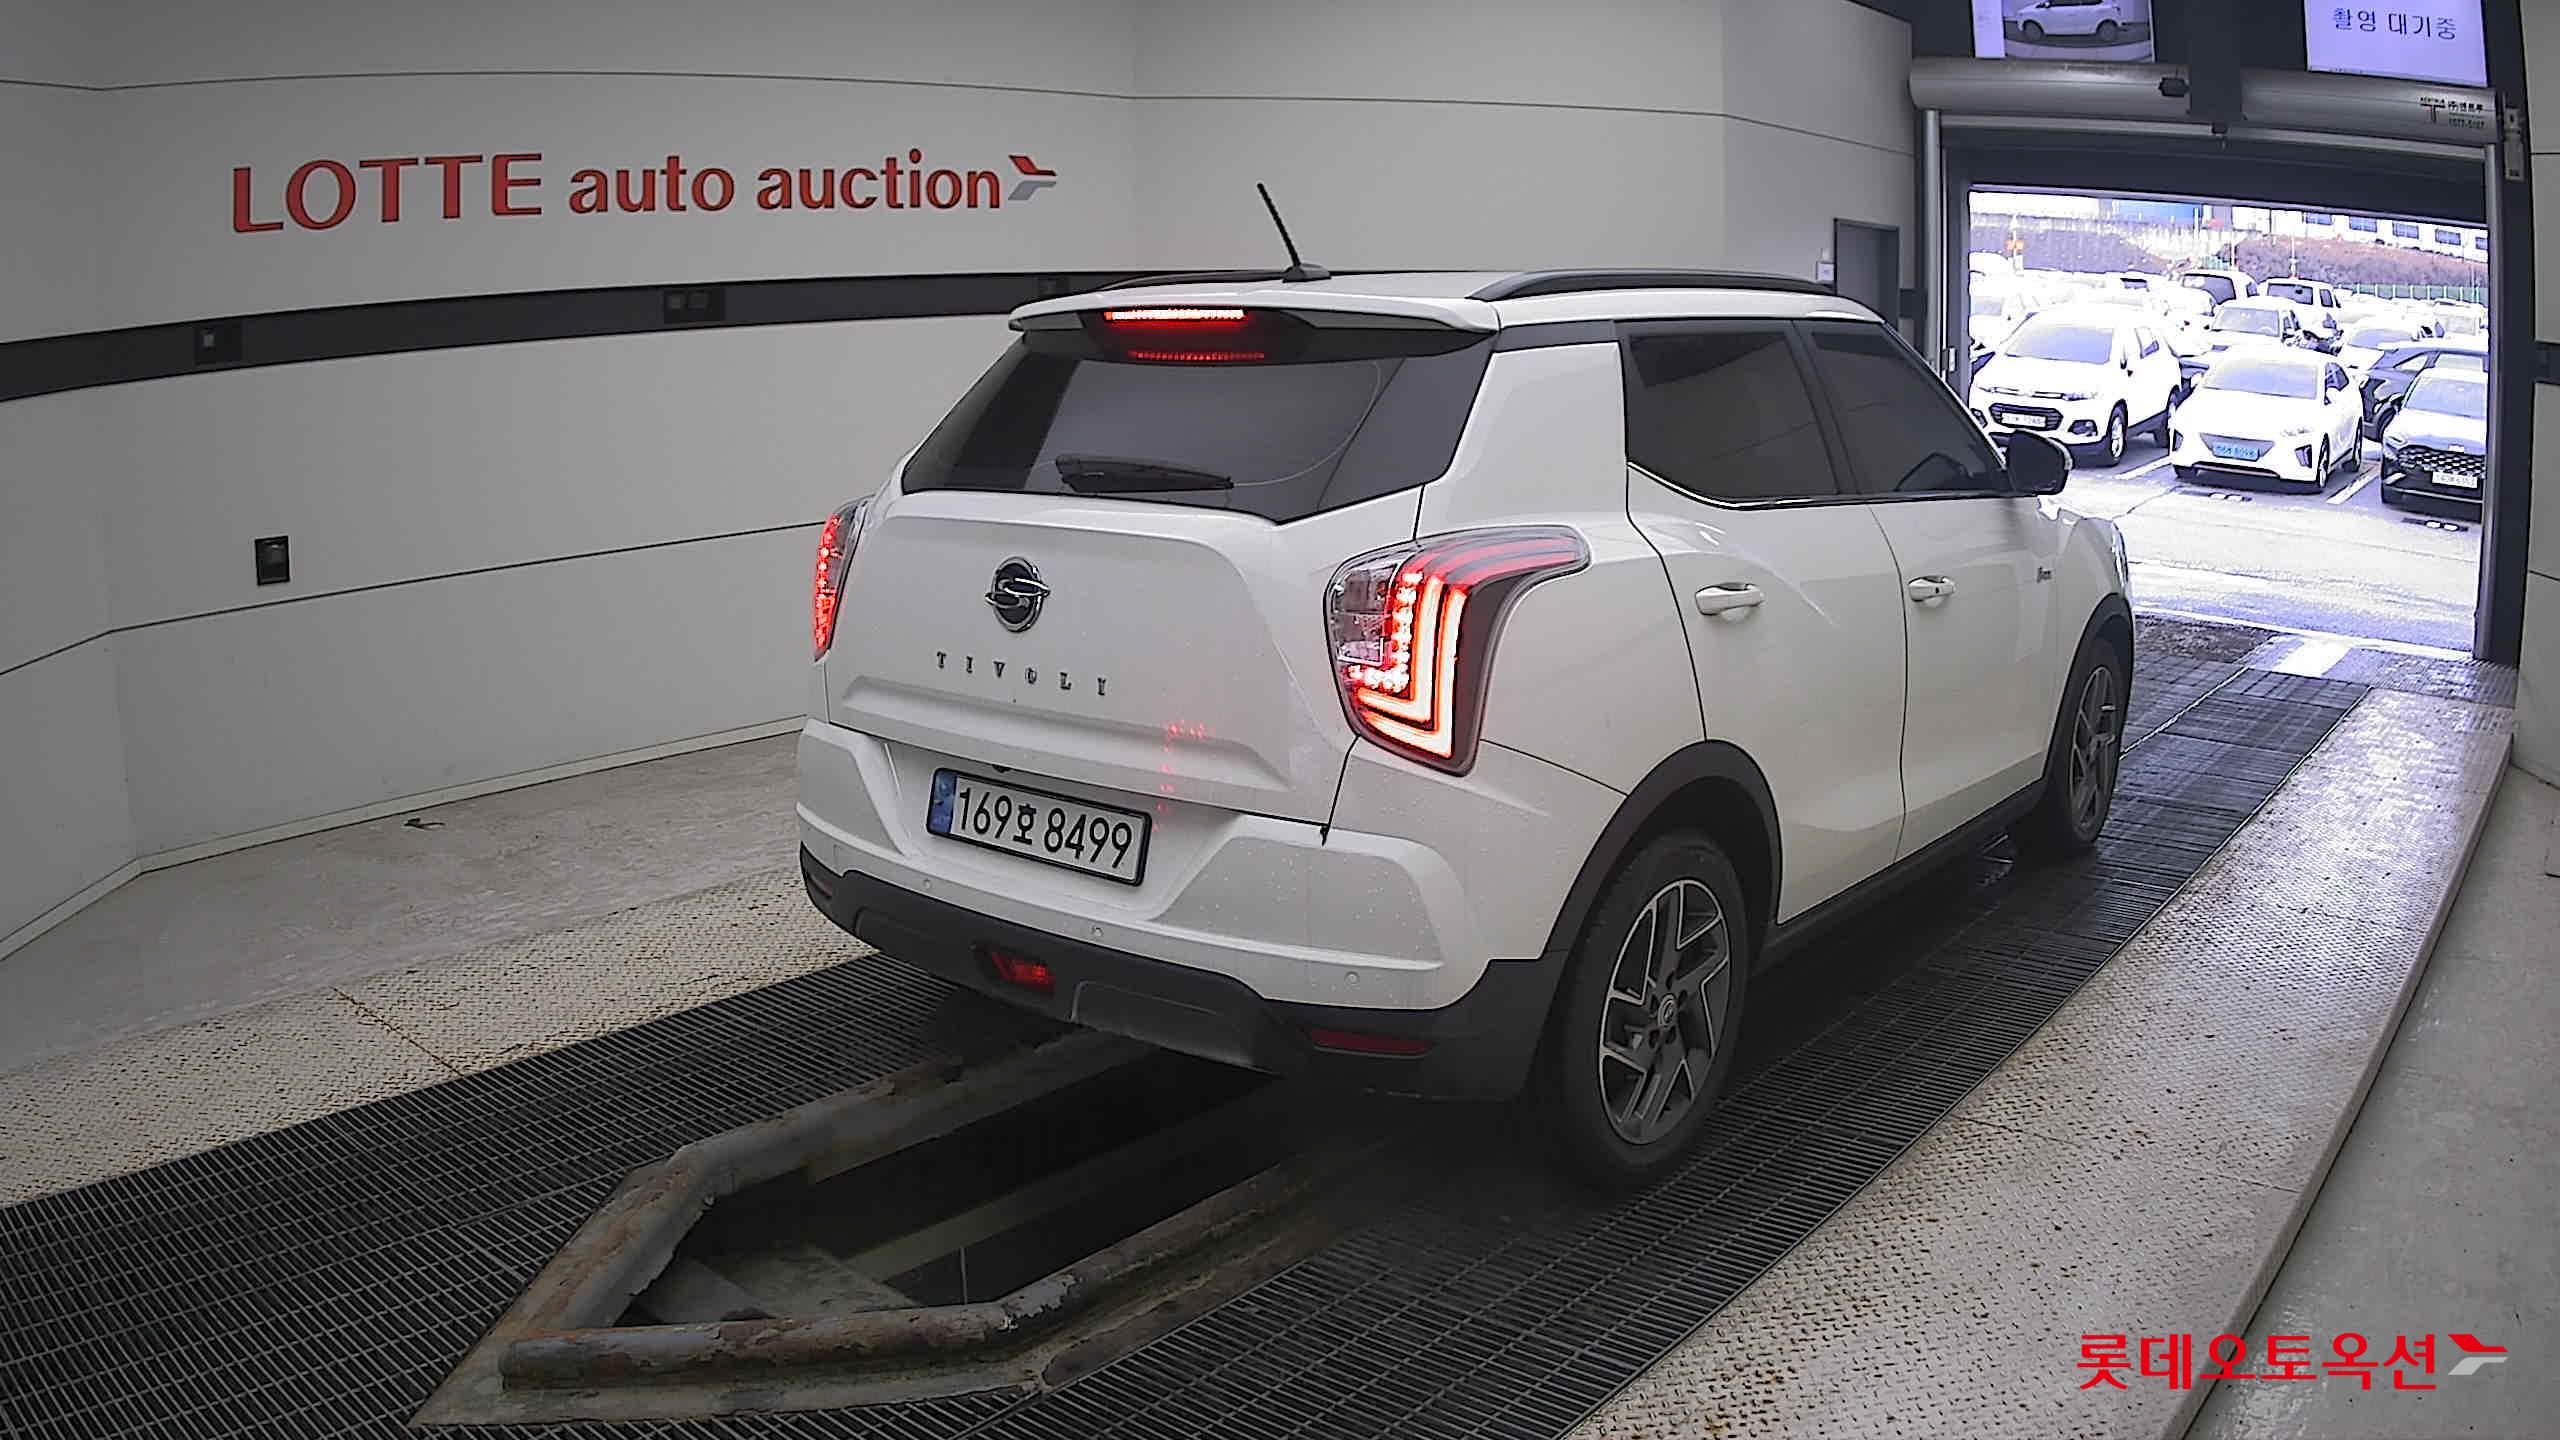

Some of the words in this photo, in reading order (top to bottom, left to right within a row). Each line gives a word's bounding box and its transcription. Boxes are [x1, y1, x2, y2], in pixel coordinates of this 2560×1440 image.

[2333, 7, 2377, 32] 촬영
[2388, 12, 2457, 40] 대기중
[233, 153, 542, 233] LOTTE
[569, 156, 735, 214] auto
[757, 149, 1001, 211] auction
[936, 651, 1107, 696] TIVOLI
